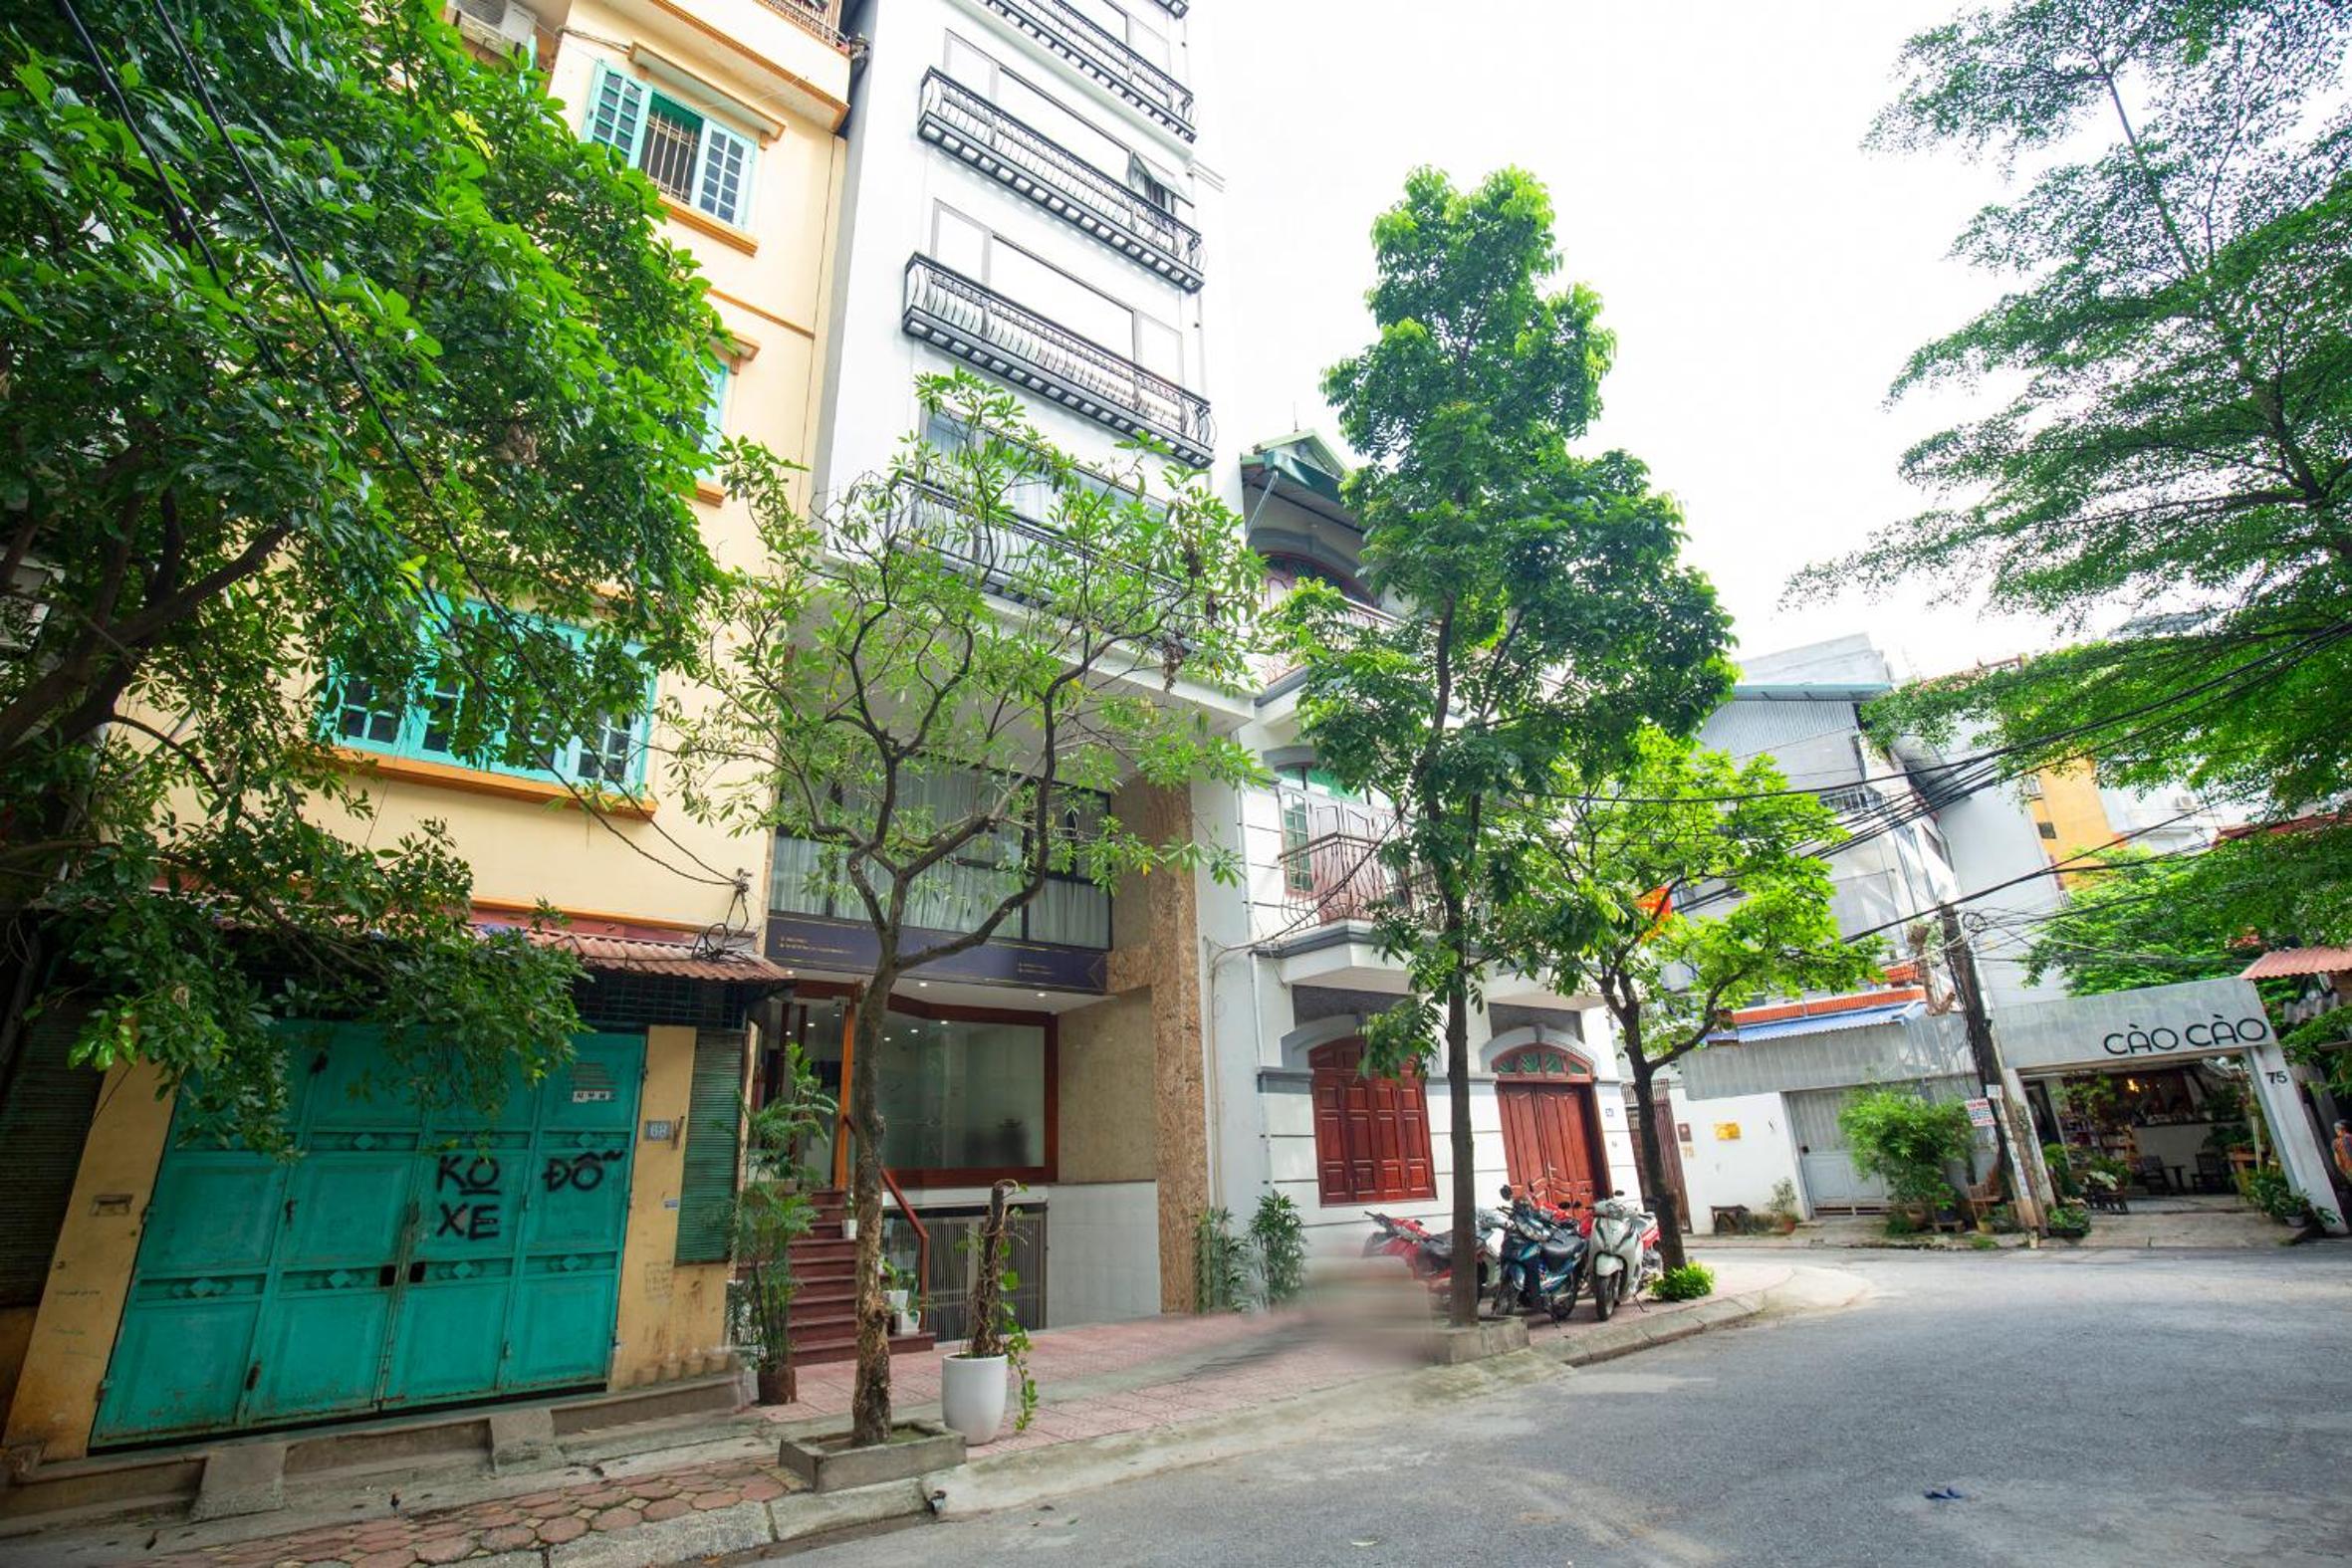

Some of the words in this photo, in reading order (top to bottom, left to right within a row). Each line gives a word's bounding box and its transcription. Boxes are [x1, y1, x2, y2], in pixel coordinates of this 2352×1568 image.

[2103, 1023, 2179, 1055] CÀO
[2185, 1013, 2267, 1046] CÀO
[2266, 1071, 2288, 1085] 75
[436, 1154, 502, 1194] KO
[436, 1203, 501, 1240] XE
